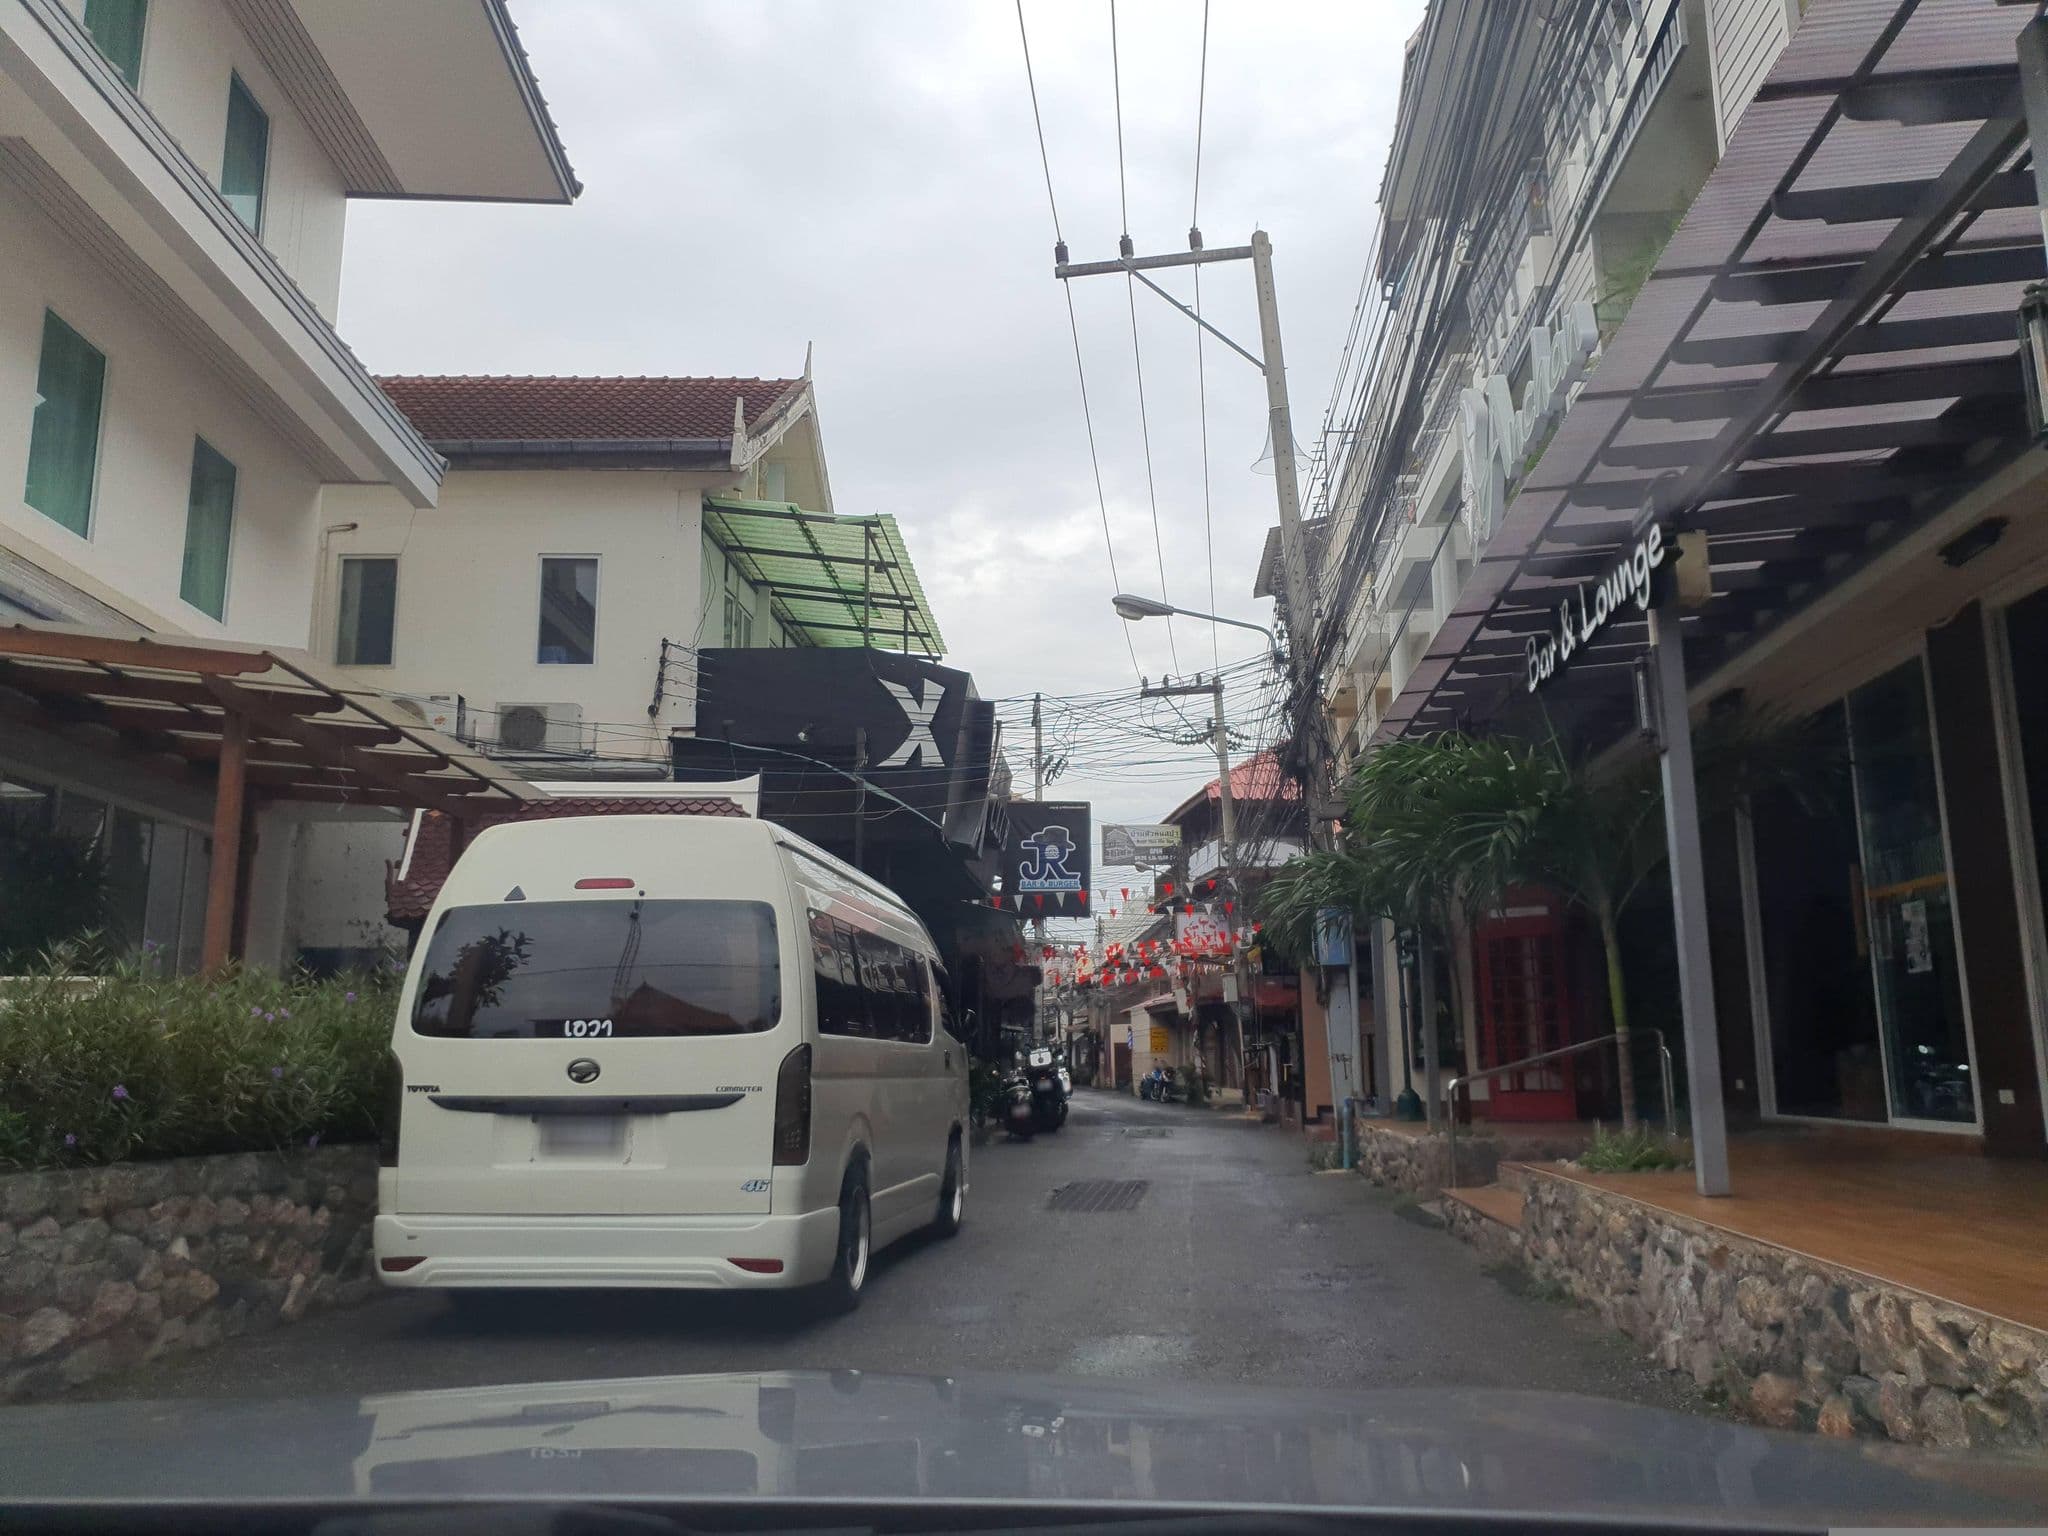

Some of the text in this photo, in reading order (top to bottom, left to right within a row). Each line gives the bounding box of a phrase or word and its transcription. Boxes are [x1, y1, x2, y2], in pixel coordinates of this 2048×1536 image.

[1525, 523, 1664, 692] Bar & Lounge
[1019, 832, 1081, 881] JR
[1021, 880, 1037, 889] BAR
[1048, 880, 1080, 889] BURGER
[407, 1085, 441, 1093] TOYOTA
